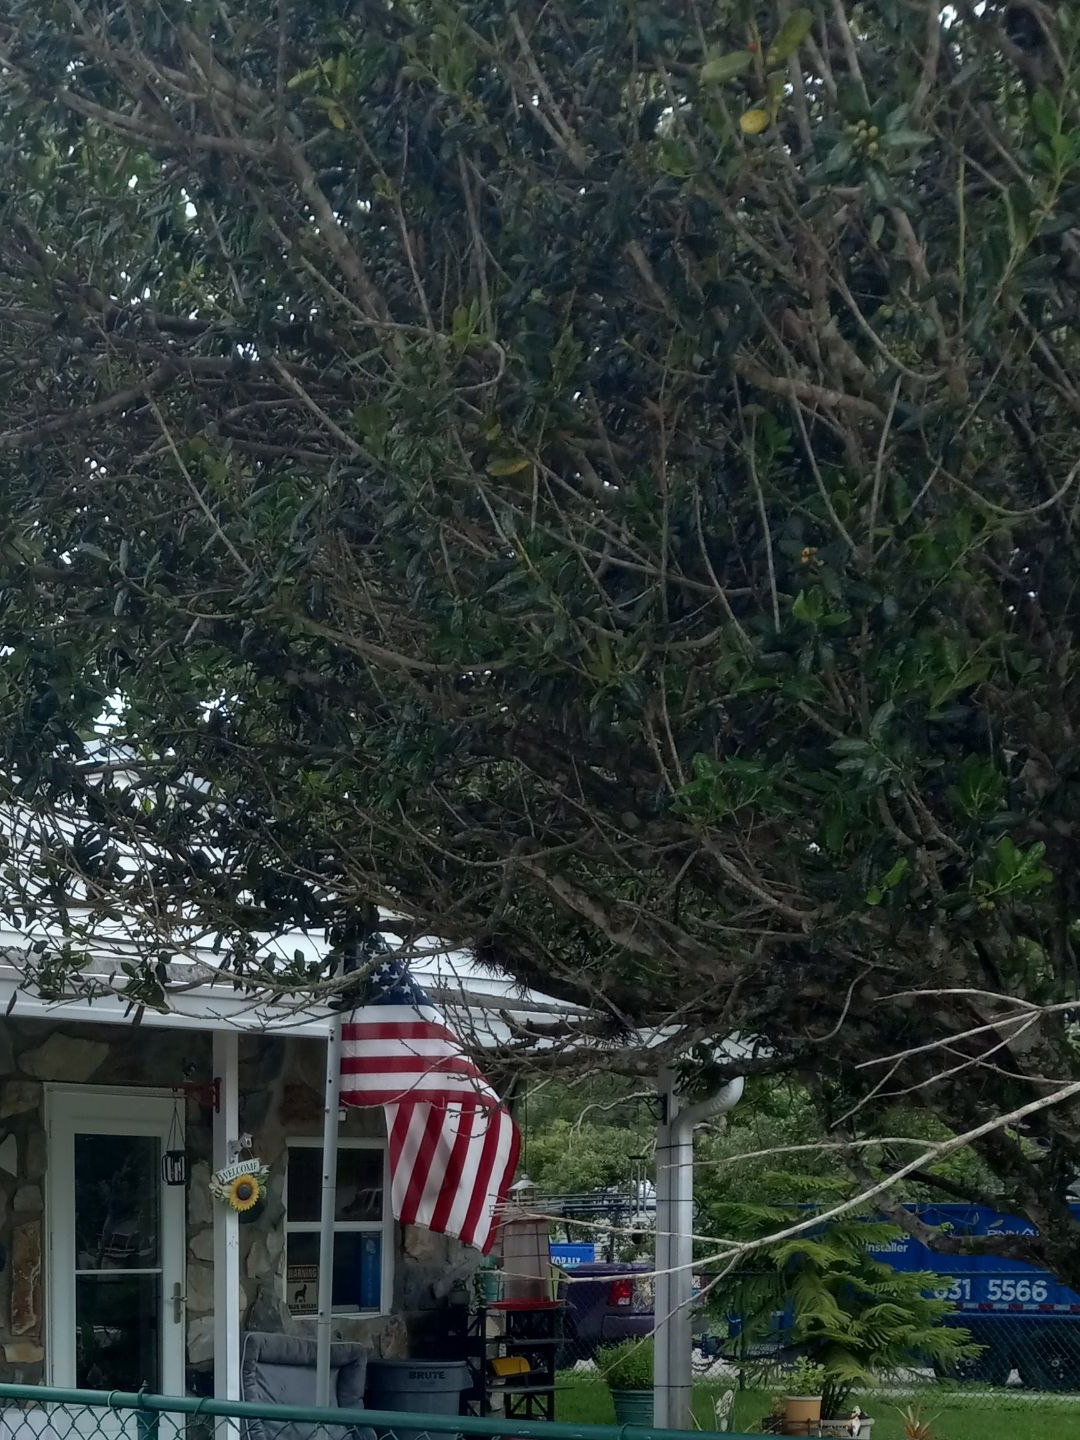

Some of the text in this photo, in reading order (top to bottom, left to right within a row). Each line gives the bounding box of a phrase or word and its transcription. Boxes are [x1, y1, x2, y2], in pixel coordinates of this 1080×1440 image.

[220, 1161, 258, 1182] WELCOME
[288, 1267, 317, 1278] WARNING
[987, 1279, 1048, 1302] 5566
[408, 1371, 446, 1380] BRUTE
